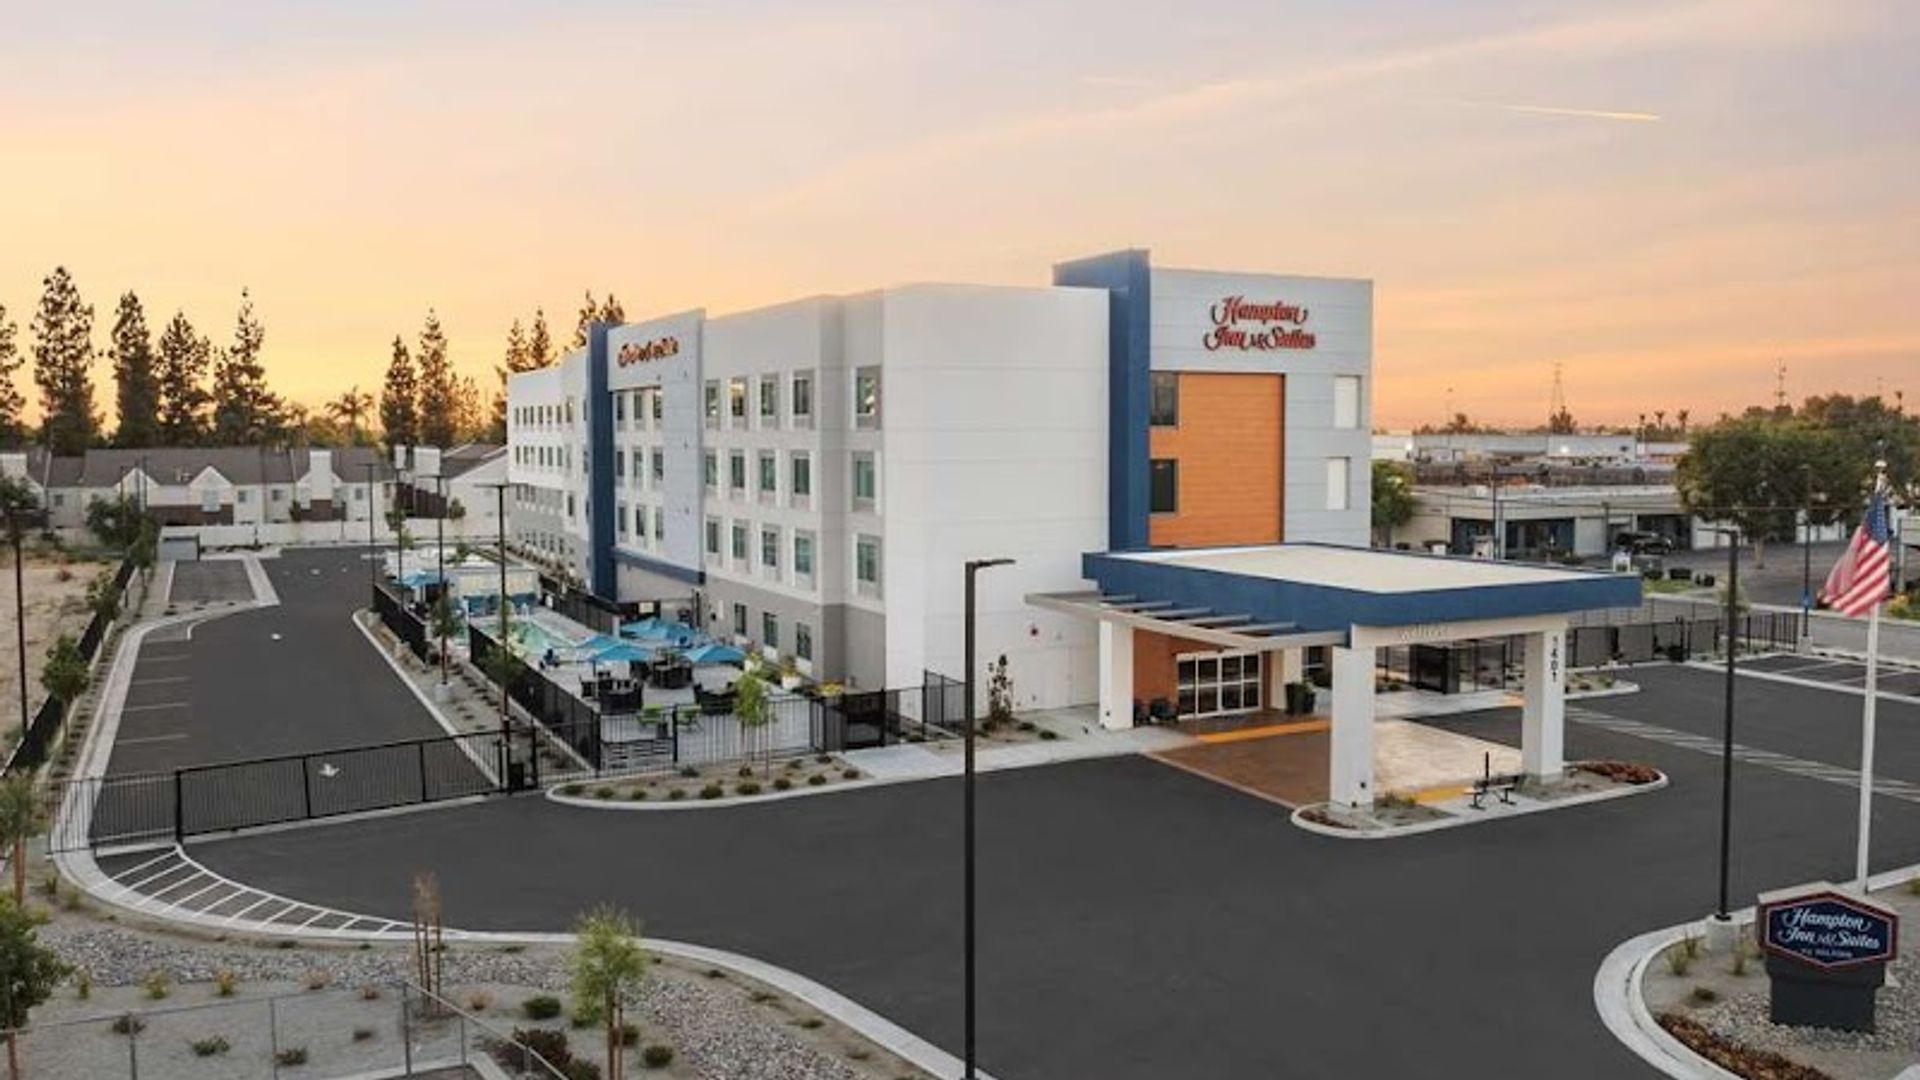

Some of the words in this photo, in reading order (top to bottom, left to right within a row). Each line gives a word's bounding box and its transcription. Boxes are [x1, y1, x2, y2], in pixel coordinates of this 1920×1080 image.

[1211, 296, 1308, 325] Hampton
[1204, 325, 1250, 350] Inn
[1265, 326, 1316, 349] Suites
[1782, 907, 1871, 932] Hampton
[1778, 927, 1818, 944] Inn
[1835, 931, 1880, 949] Suites
